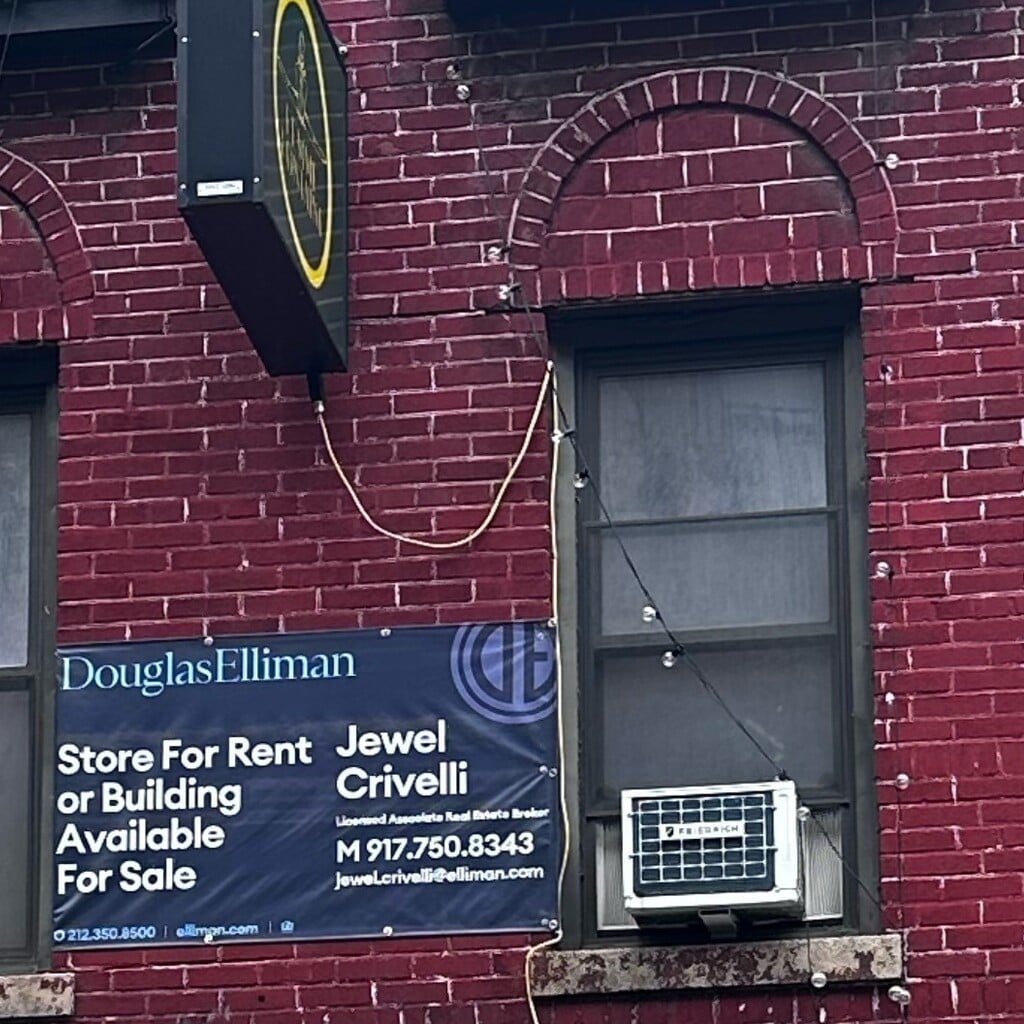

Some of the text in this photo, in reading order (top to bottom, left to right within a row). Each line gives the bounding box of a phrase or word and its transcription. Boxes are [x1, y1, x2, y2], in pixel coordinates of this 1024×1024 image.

[57, 736, 313, 775] Store For Rent
[335, 718, 446, 757] Jewel
[57, 776, 242, 817] or Building
[336, 760, 468, 799] Crivelli
[445, 810, 471, 822] Real
[511, 807, 550, 819] Broker
[55, 816, 226, 855] Available
[336, 831, 535, 863] M 917.750.8343
[57, 857, 197, 895] For Sale
[333, 866, 544, 890] jewel.crivelli@elliman.com
[67, 926, 156, 941] 212.350.8500
